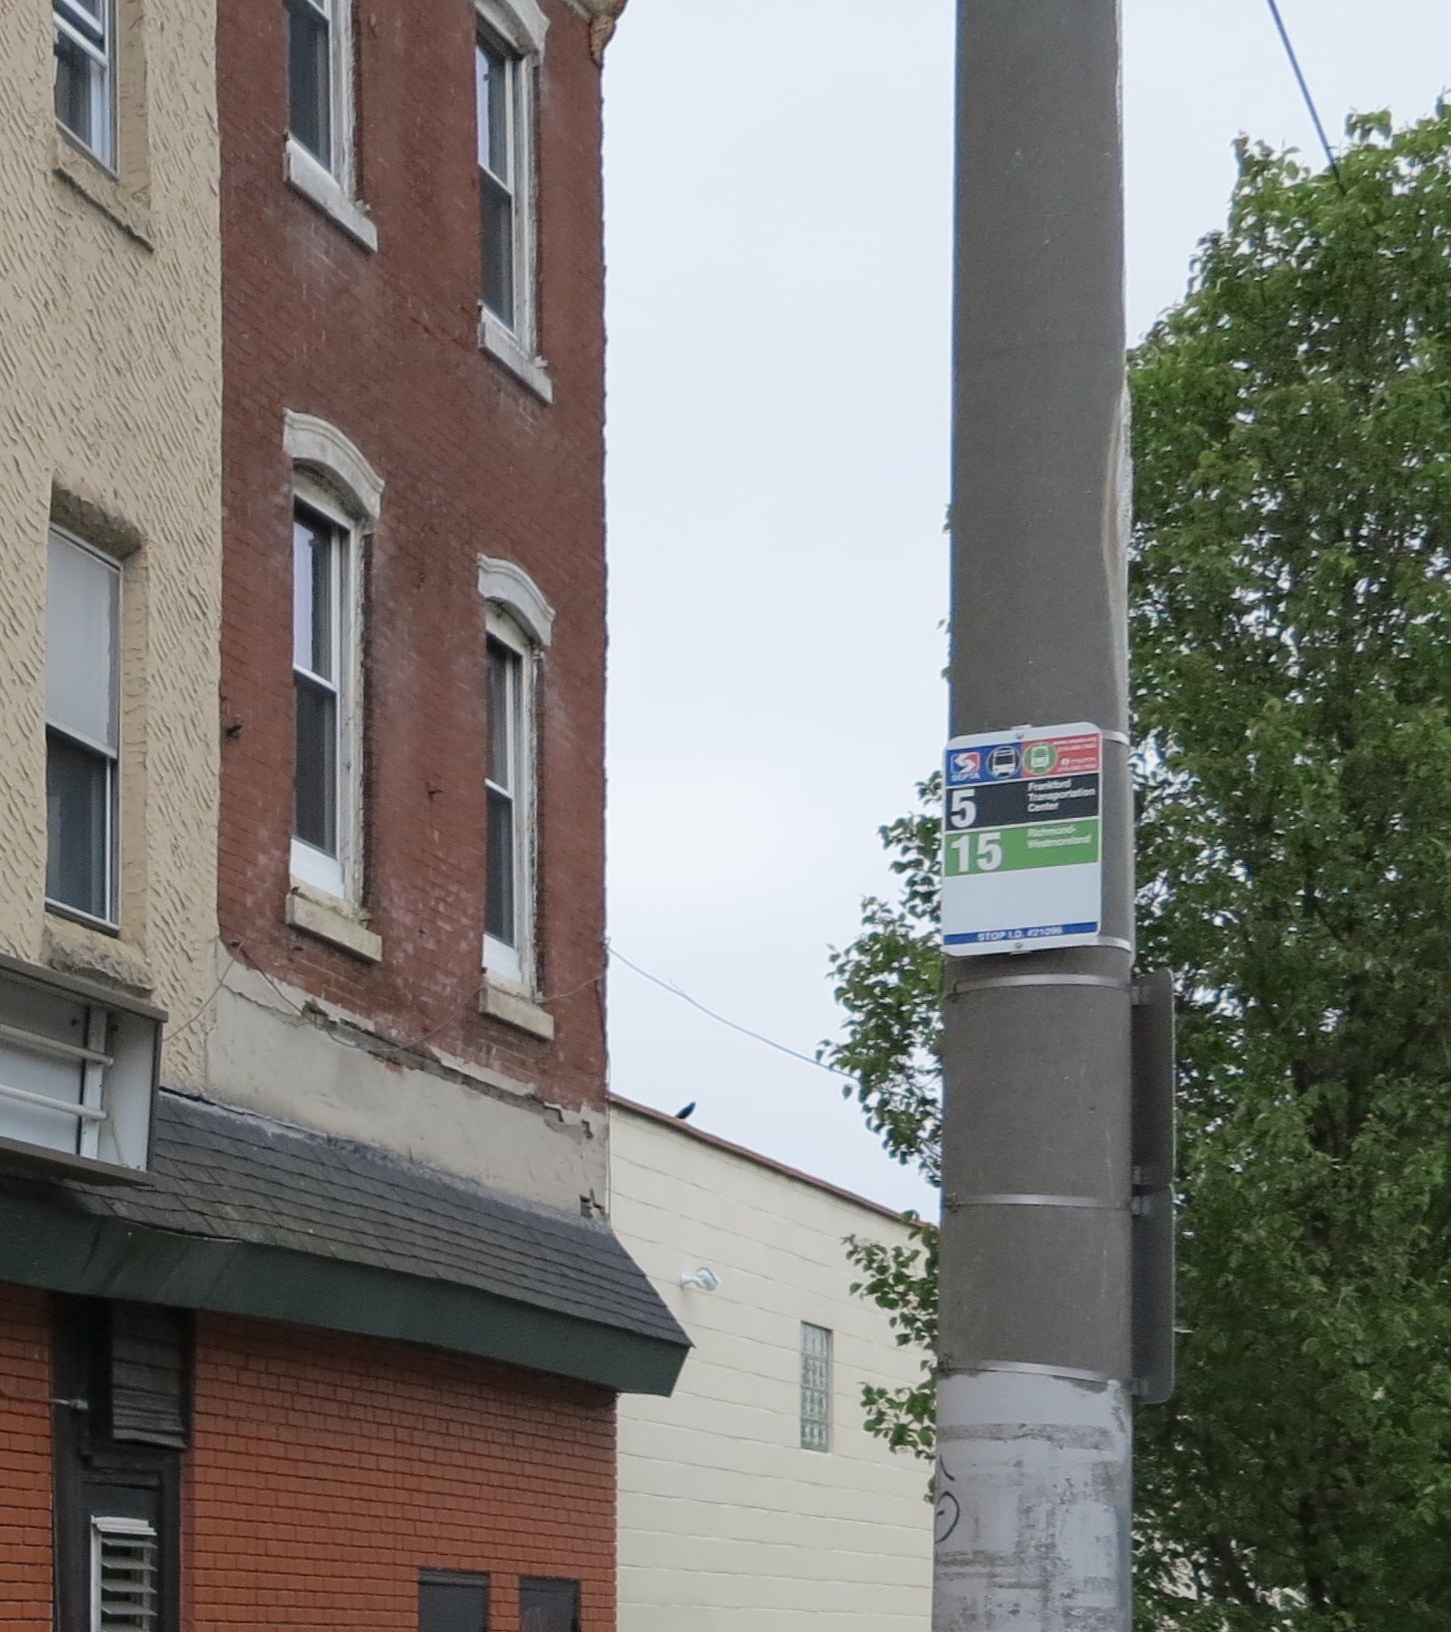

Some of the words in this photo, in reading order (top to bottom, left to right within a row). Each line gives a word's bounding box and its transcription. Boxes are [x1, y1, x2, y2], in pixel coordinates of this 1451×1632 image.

[1027, 779, 1071, 791] Frankford
[1027, 788, 1096, 801] Transportation
[951, 789, 976, 828] 5
[1027, 802, 1059, 812] Center
[951, 832, 1002, 872] 15
[978, 931, 1006, 941] STOP
